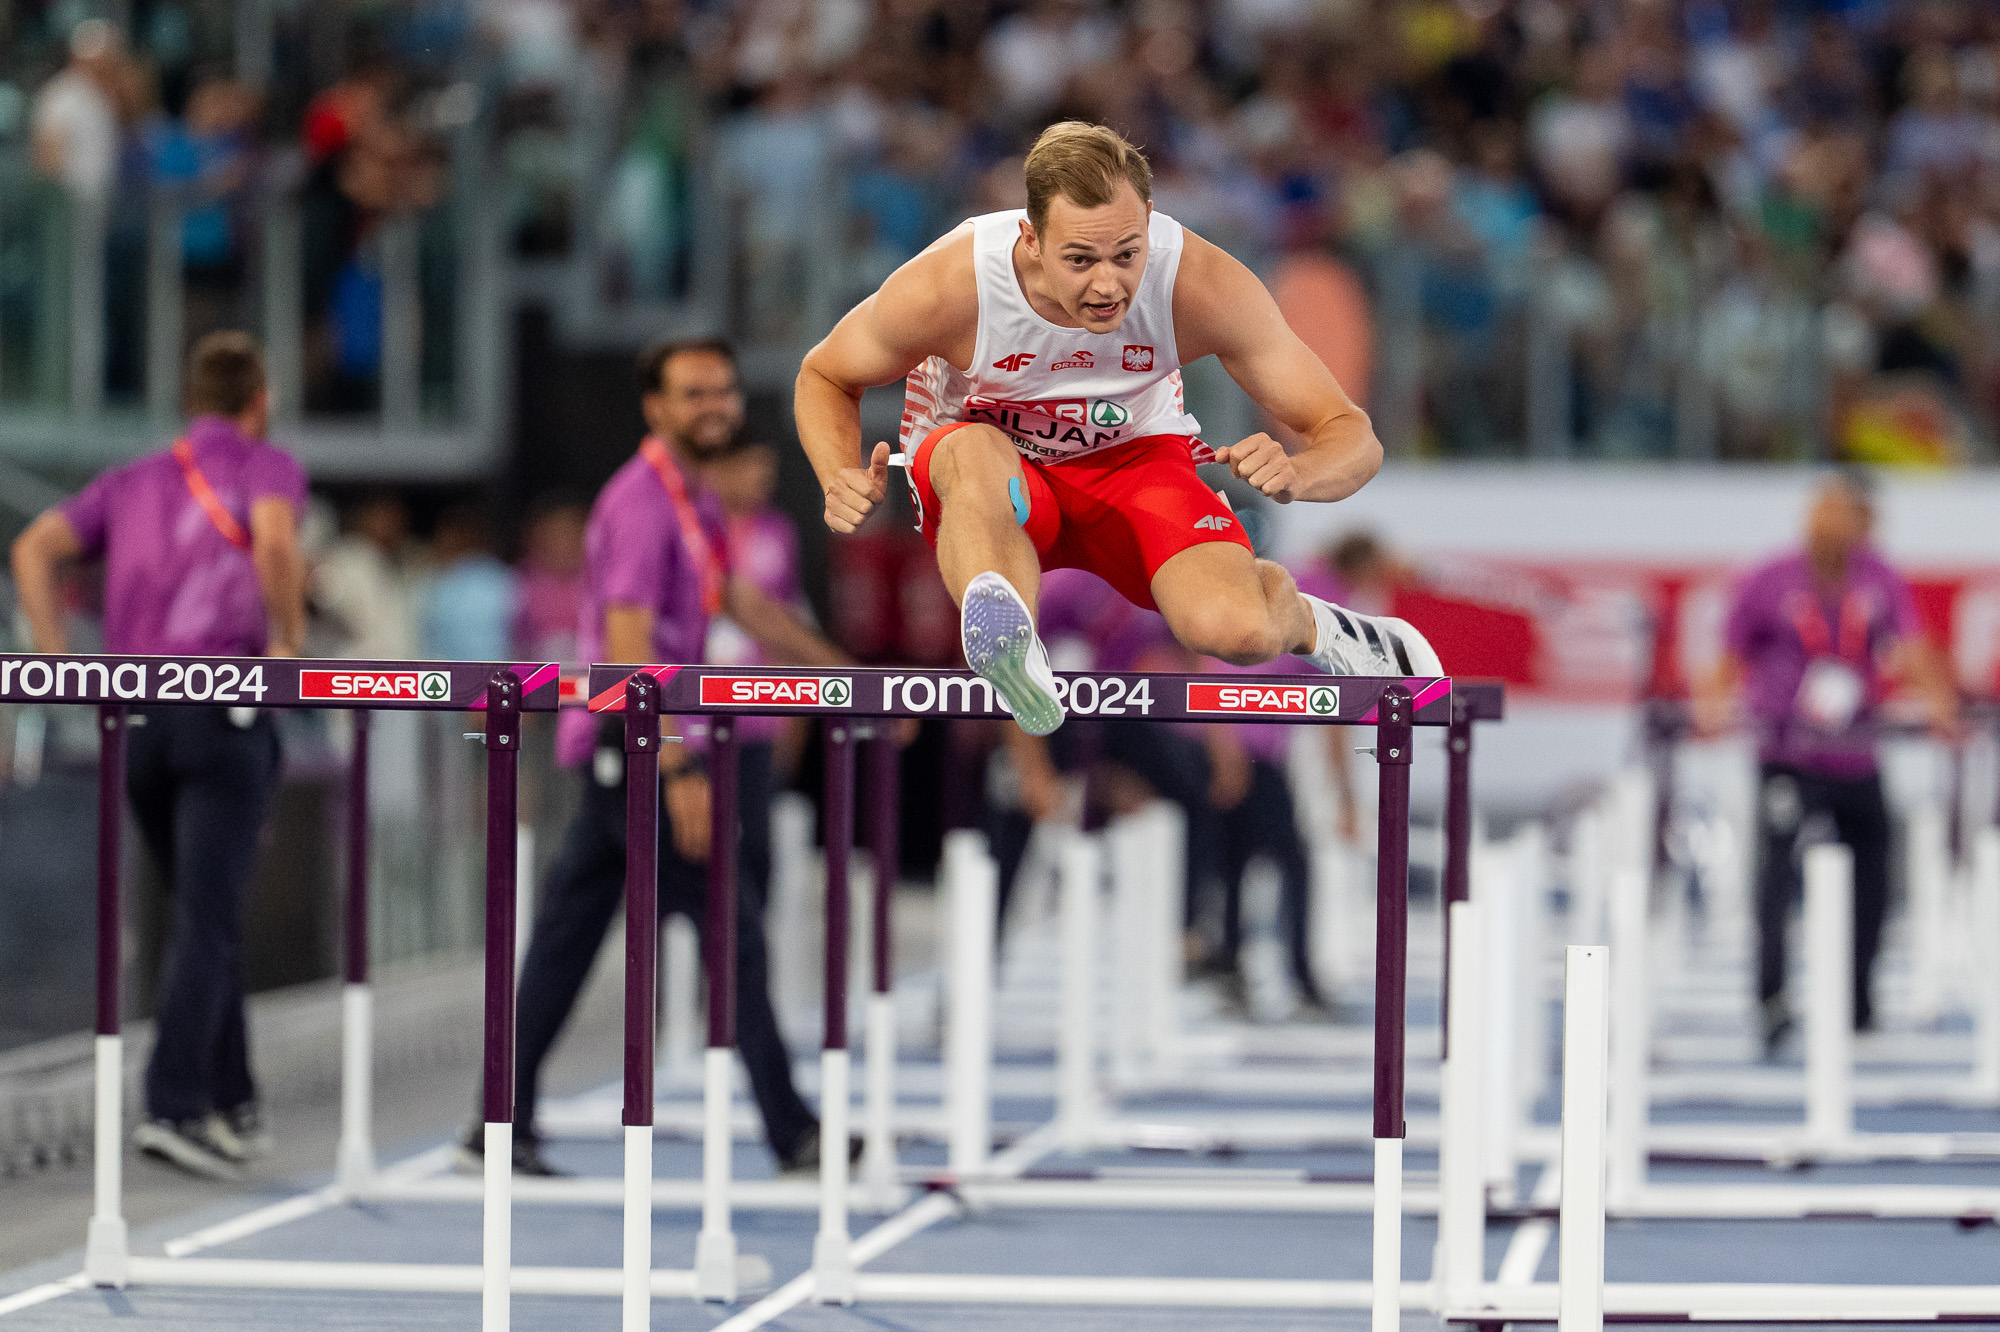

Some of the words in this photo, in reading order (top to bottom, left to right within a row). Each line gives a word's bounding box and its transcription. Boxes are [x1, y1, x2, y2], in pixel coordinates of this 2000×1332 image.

[993, 353, 1037, 372] 4F
[1053, 361, 1092, 370] ORLEN
[970, 408, 1121, 449] KILJAN
[1193, 514, 1233, 531] 4F
[1, 660, 147, 699] roma
[157, 662, 269, 702] 2024
[331, 675, 417, 696] SPAR
[732, 681, 818, 701] SPAR
[1218, 688, 1305, 710] SPAR
